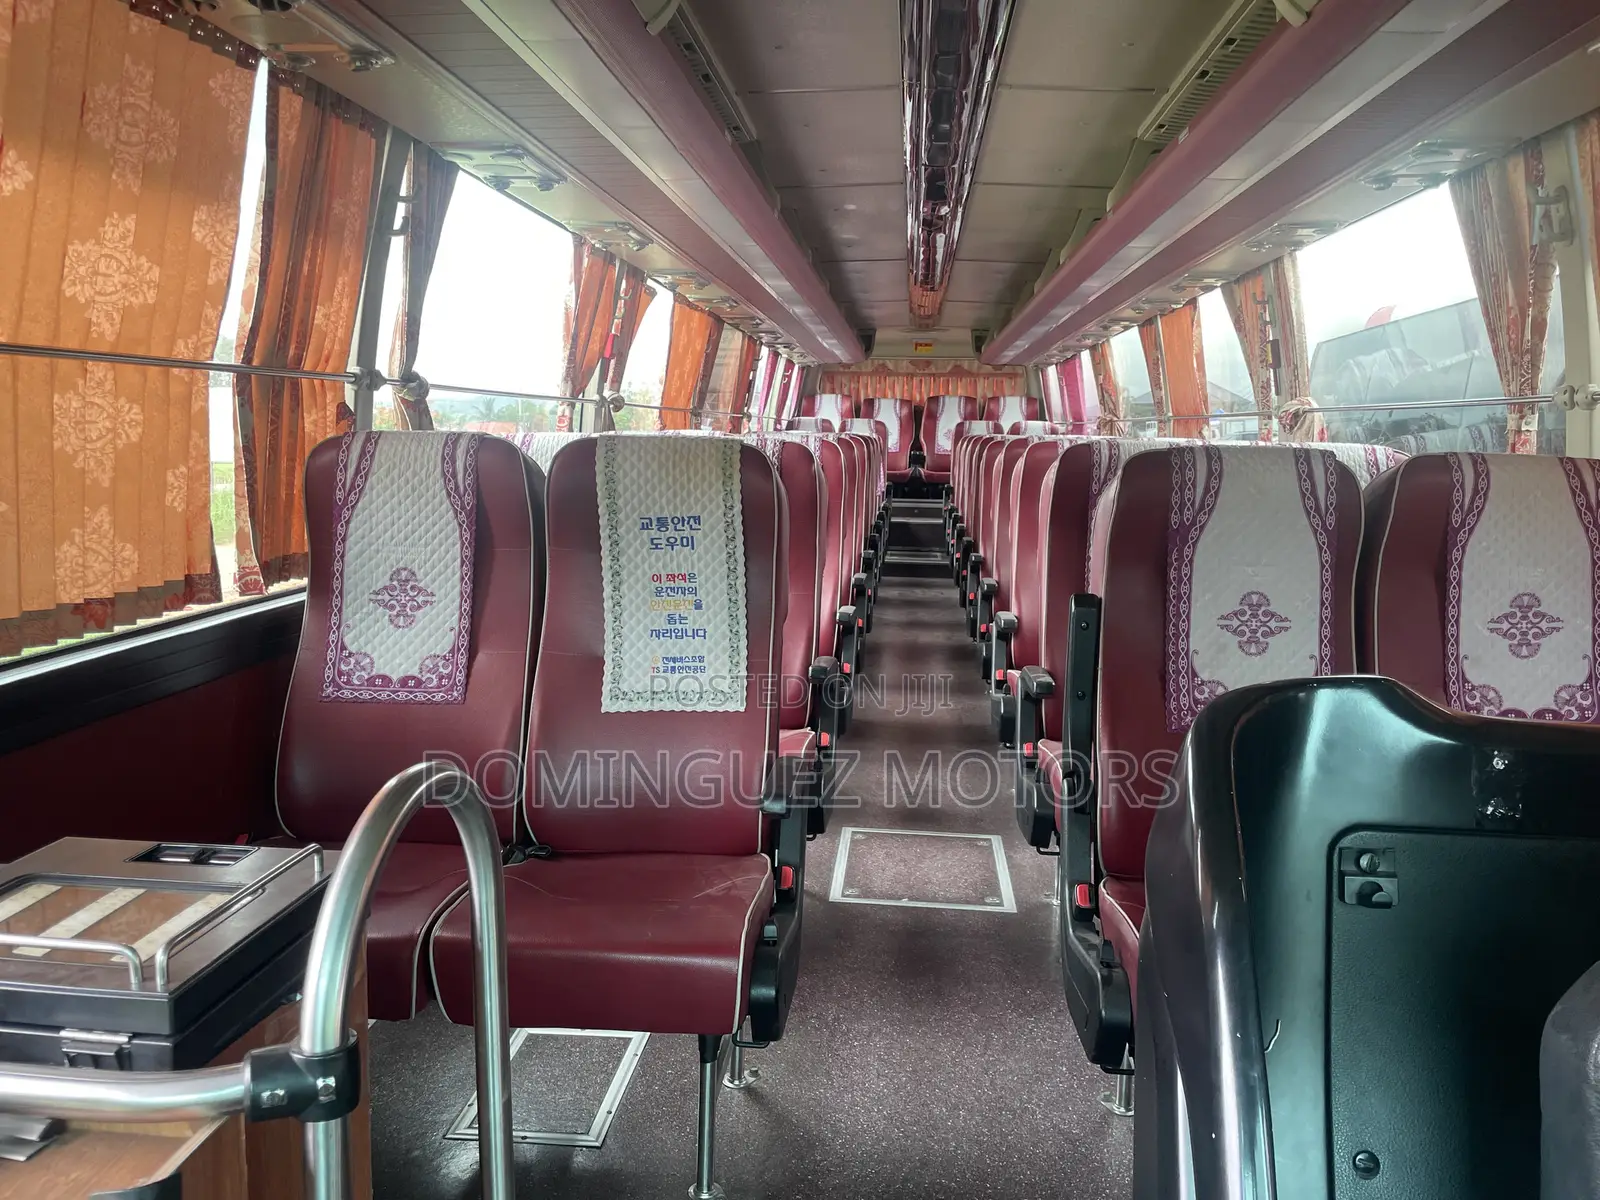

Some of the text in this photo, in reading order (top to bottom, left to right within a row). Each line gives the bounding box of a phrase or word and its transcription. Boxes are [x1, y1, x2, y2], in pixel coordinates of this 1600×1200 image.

[639, 515, 702, 532] 교통안전
[649, 535, 695, 551] 도우미
[651, 572, 698, 584] 이 좌석은
[654, 586, 698, 598] 운전자의
[666, 613, 689, 625] 돕는
[650, 627, 708, 640] 자리입니다
[651, 666, 661, 674] TS
